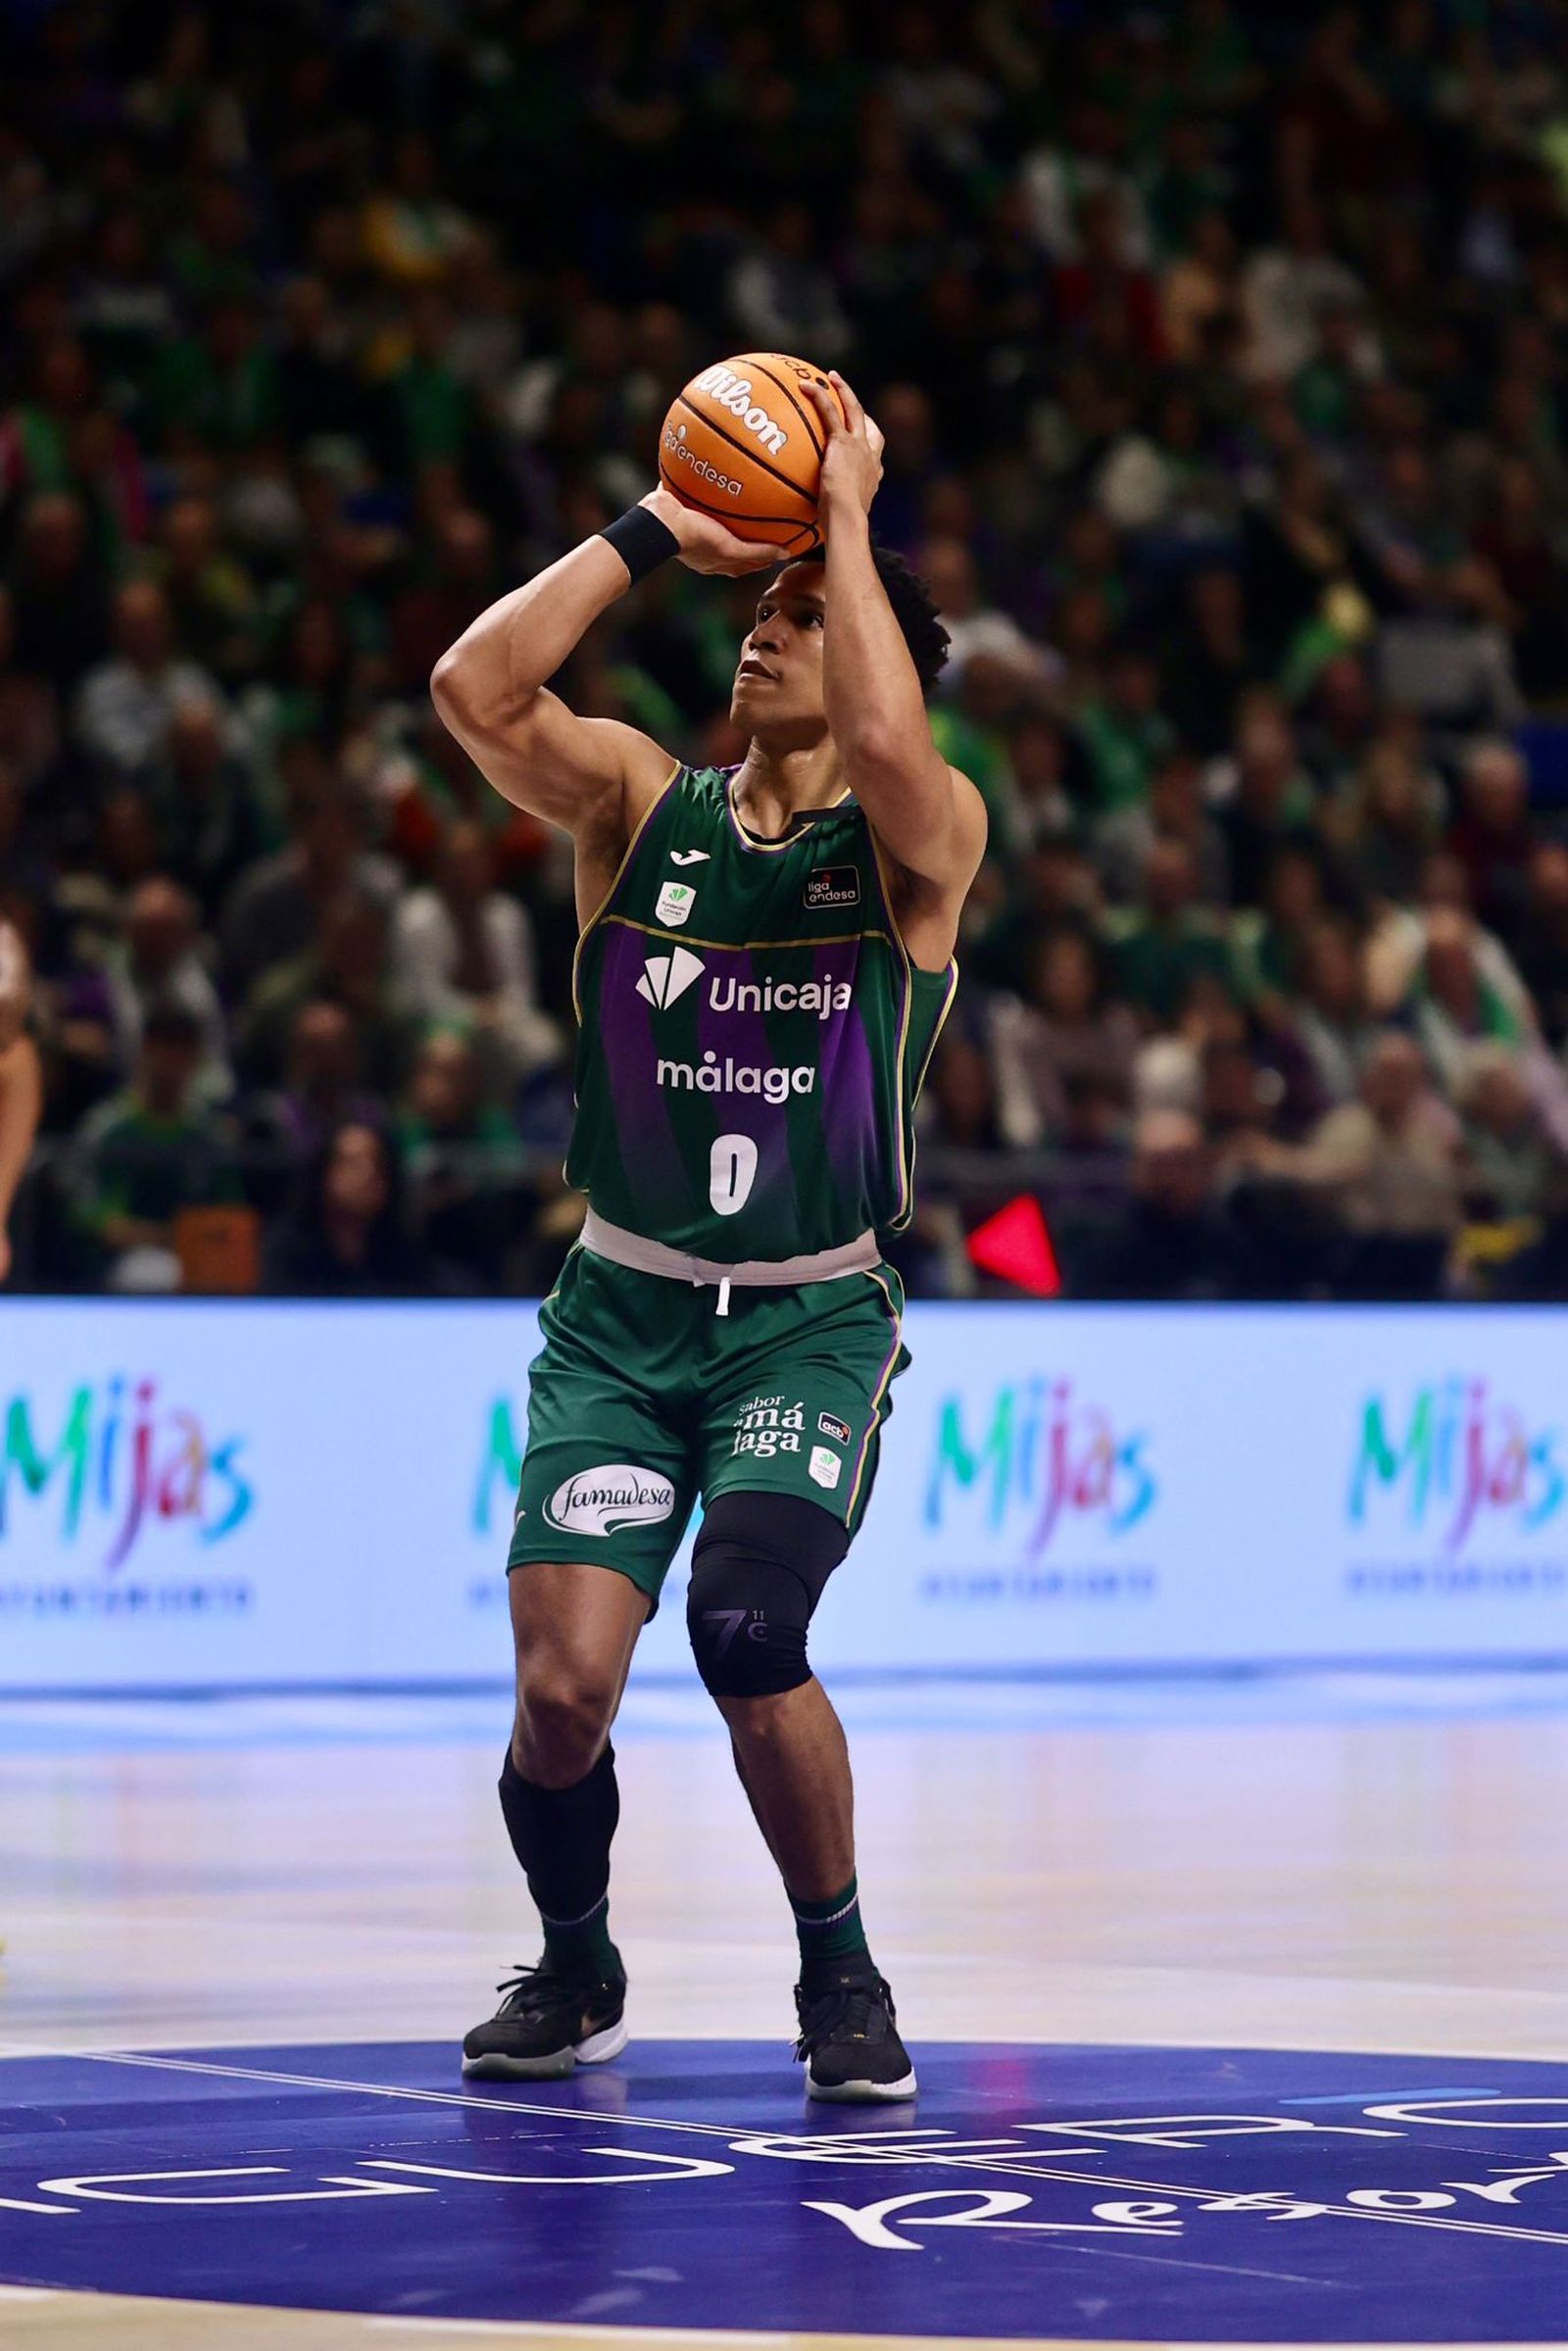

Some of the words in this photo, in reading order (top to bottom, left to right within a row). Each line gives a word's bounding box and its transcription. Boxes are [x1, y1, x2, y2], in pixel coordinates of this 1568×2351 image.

[677, 445, 742, 496] endesa
[808, 881, 830, 893] liga
[808, 890, 856, 903] endesa
[709, 974, 853, 1020] Unicaja
[657, 1051, 815, 1104] málaga
[710, 1134, 758, 1215] 0
[739, 1396, 785, 1415] sabor
[822, 1421, 844, 1439] acb
[730, 1430, 801, 1457] laga
[923, 1372, 1158, 1563] Mijas
[1347, 1372, 1566, 1558] Mijas
[0, 1372, 255, 1573] Mijas
[558, 1470, 670, 1521] famadesa
[801, 2151, 1568, 2250] Resor
